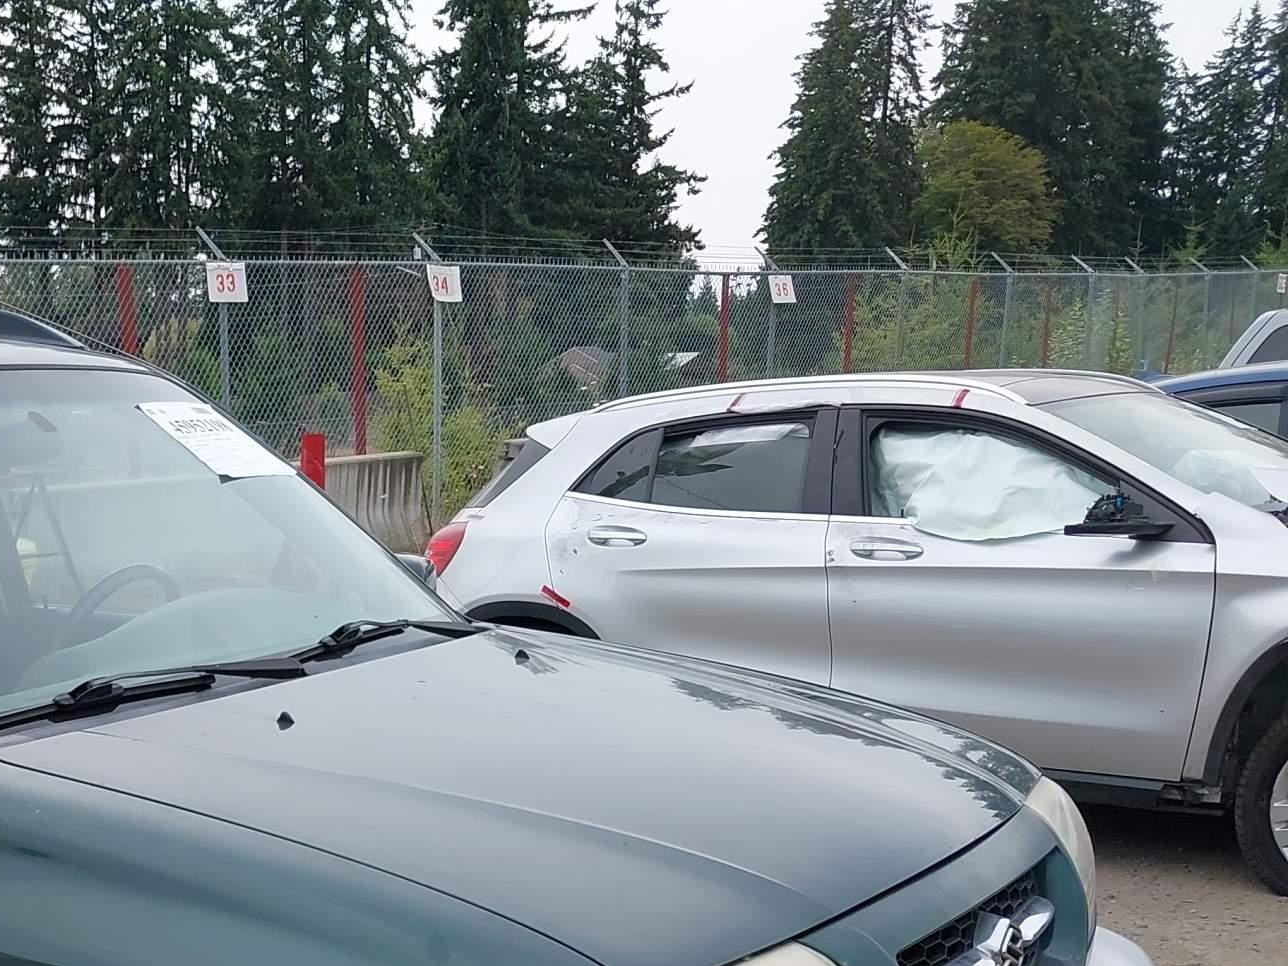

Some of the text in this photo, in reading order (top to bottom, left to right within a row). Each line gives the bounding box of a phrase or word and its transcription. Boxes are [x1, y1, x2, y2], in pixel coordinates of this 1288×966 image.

[216, 273, 236, 293] 33
[433, 274, 449, 295] 34
[774, 282, 789, 297] 36
